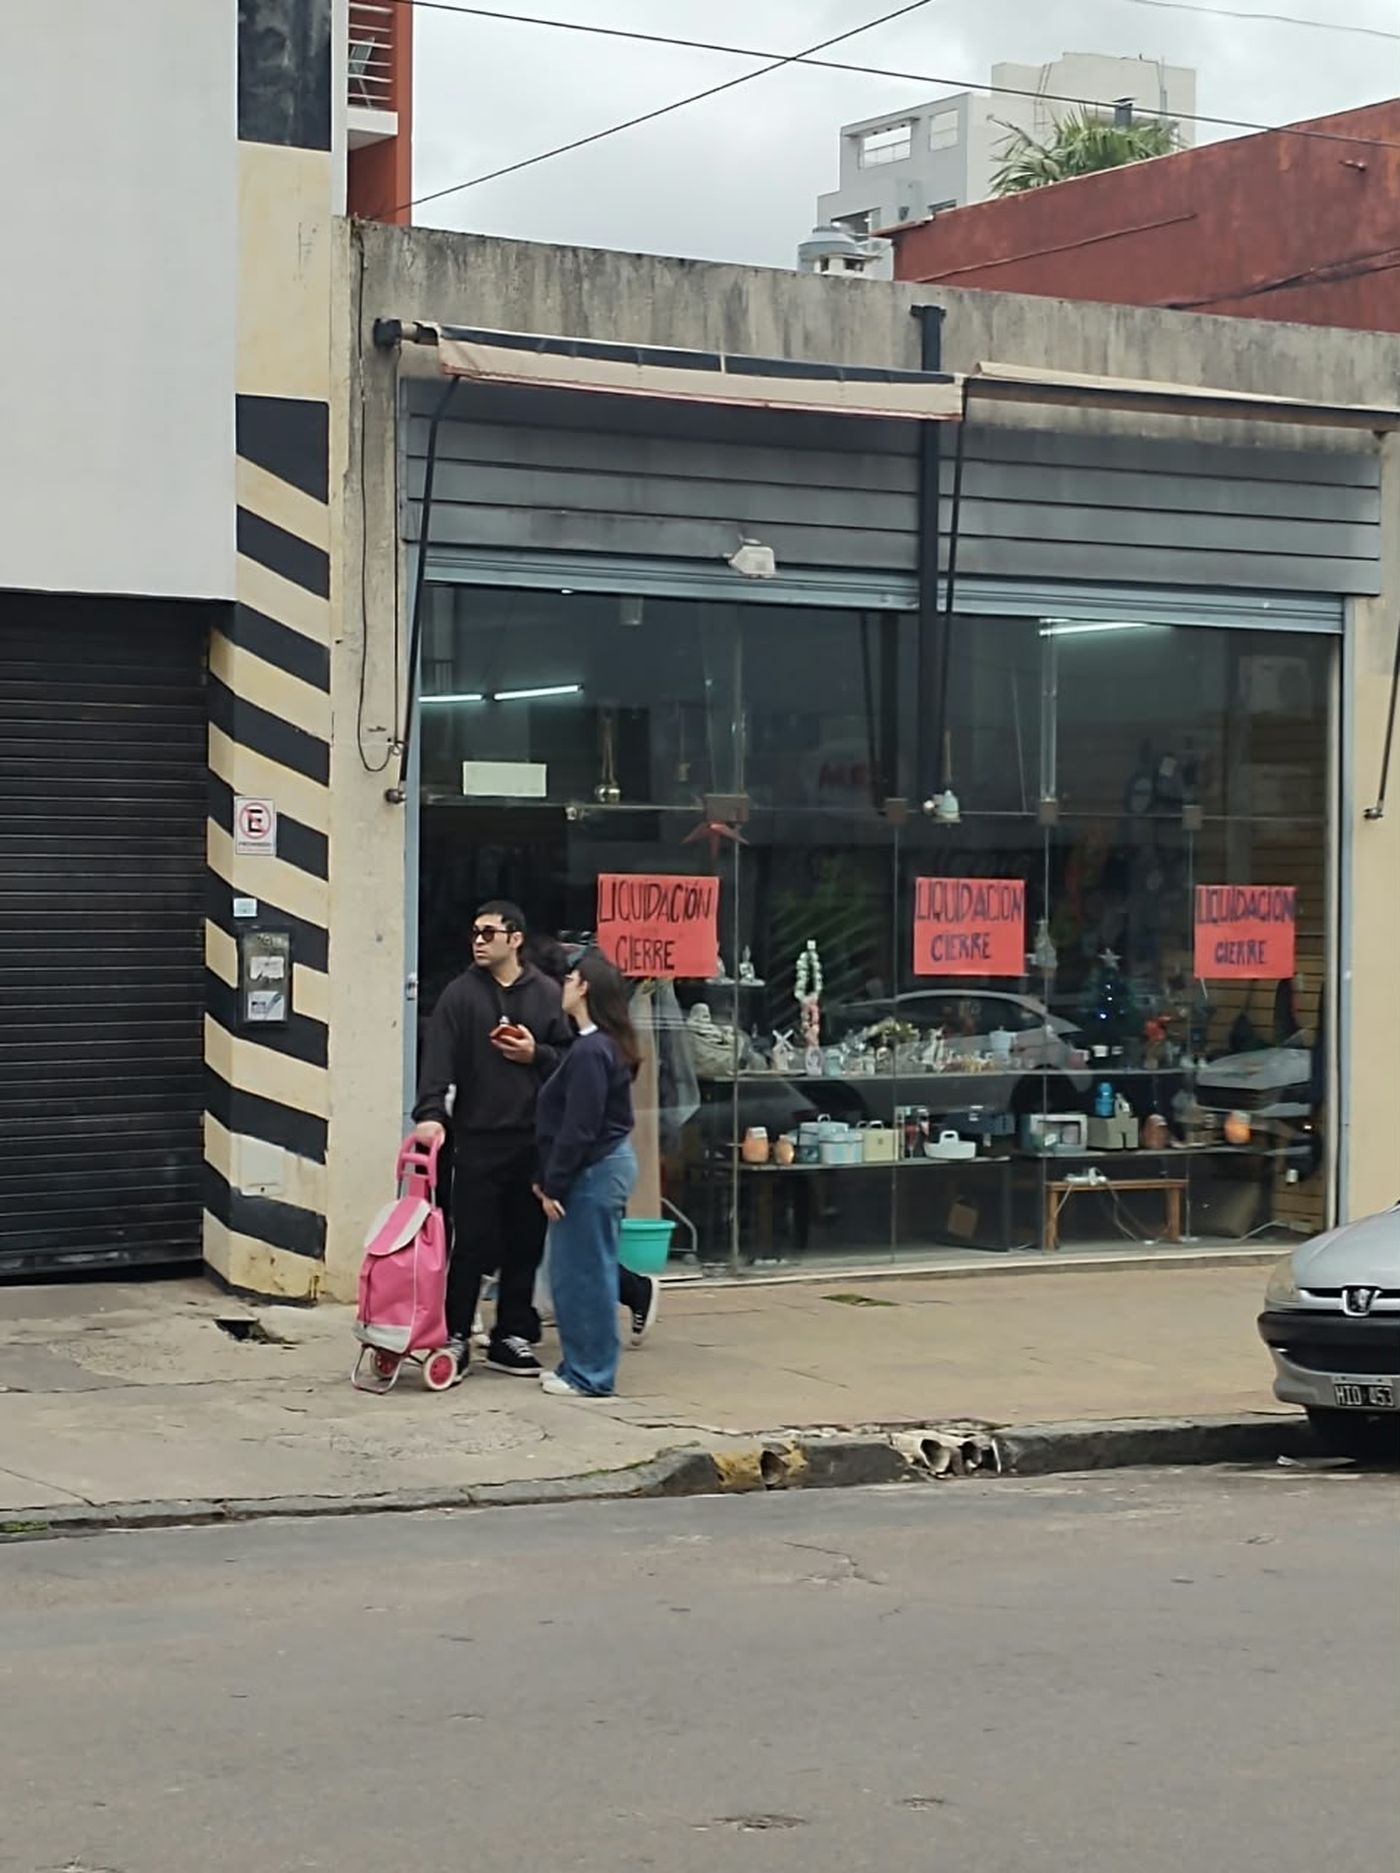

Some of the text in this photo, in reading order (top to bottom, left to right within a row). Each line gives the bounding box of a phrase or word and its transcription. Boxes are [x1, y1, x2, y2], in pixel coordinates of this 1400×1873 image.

[248, 809, 263, 833] E
[615, 934, 675, 972] CIERRE
[930, 932, 991, 962] CIERRE
[1215, 939, 1266, 964] CIERRE
